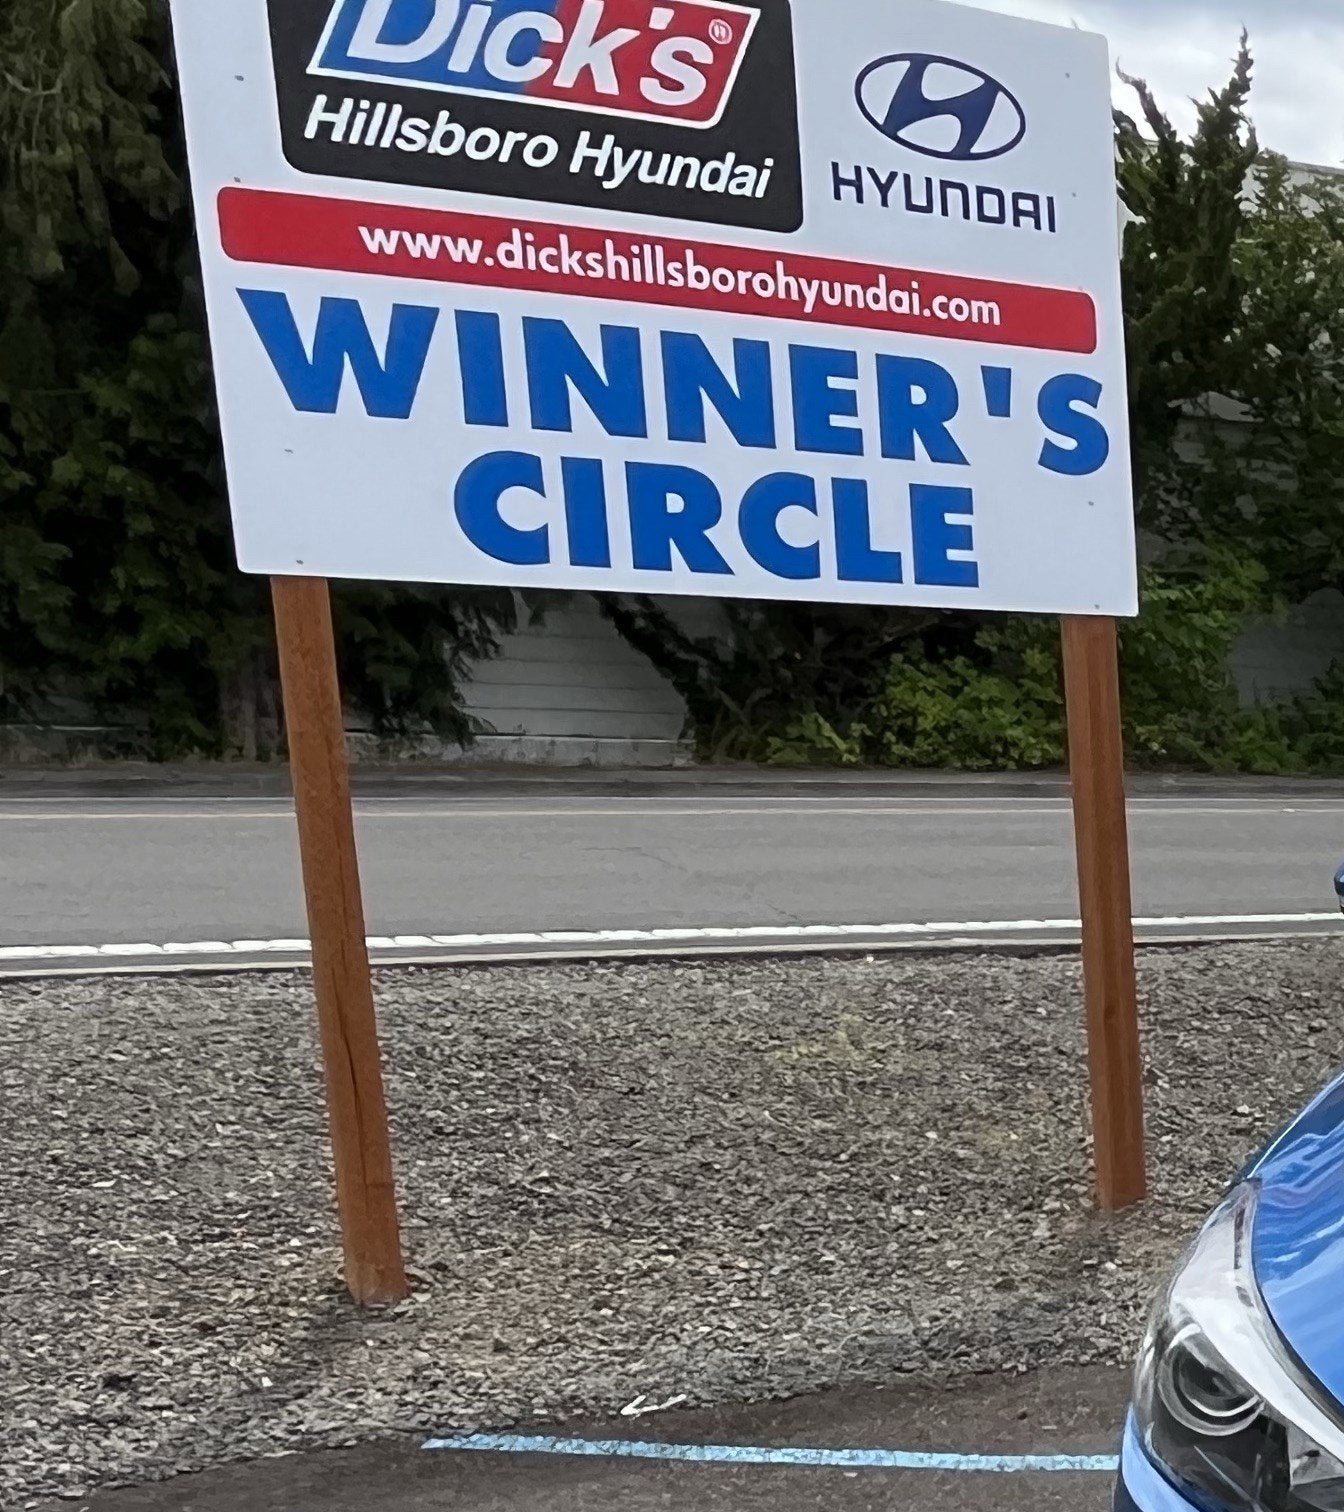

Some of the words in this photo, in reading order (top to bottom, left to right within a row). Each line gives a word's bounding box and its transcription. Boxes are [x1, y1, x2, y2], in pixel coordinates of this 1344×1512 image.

[346, 0, 715, 106] Dick's
[303, 94, 559, 168] Hillsboro
[568, 130, 775, 198] Hyundai
[832, 160, 1058, 234] HYUNDAI
[358, 223, 1001, 326] www.dickshillsborohyundai.com
[236, 288, 1109, 477] WINNER'S
[453, 449, 981, 589] CIRCLE
